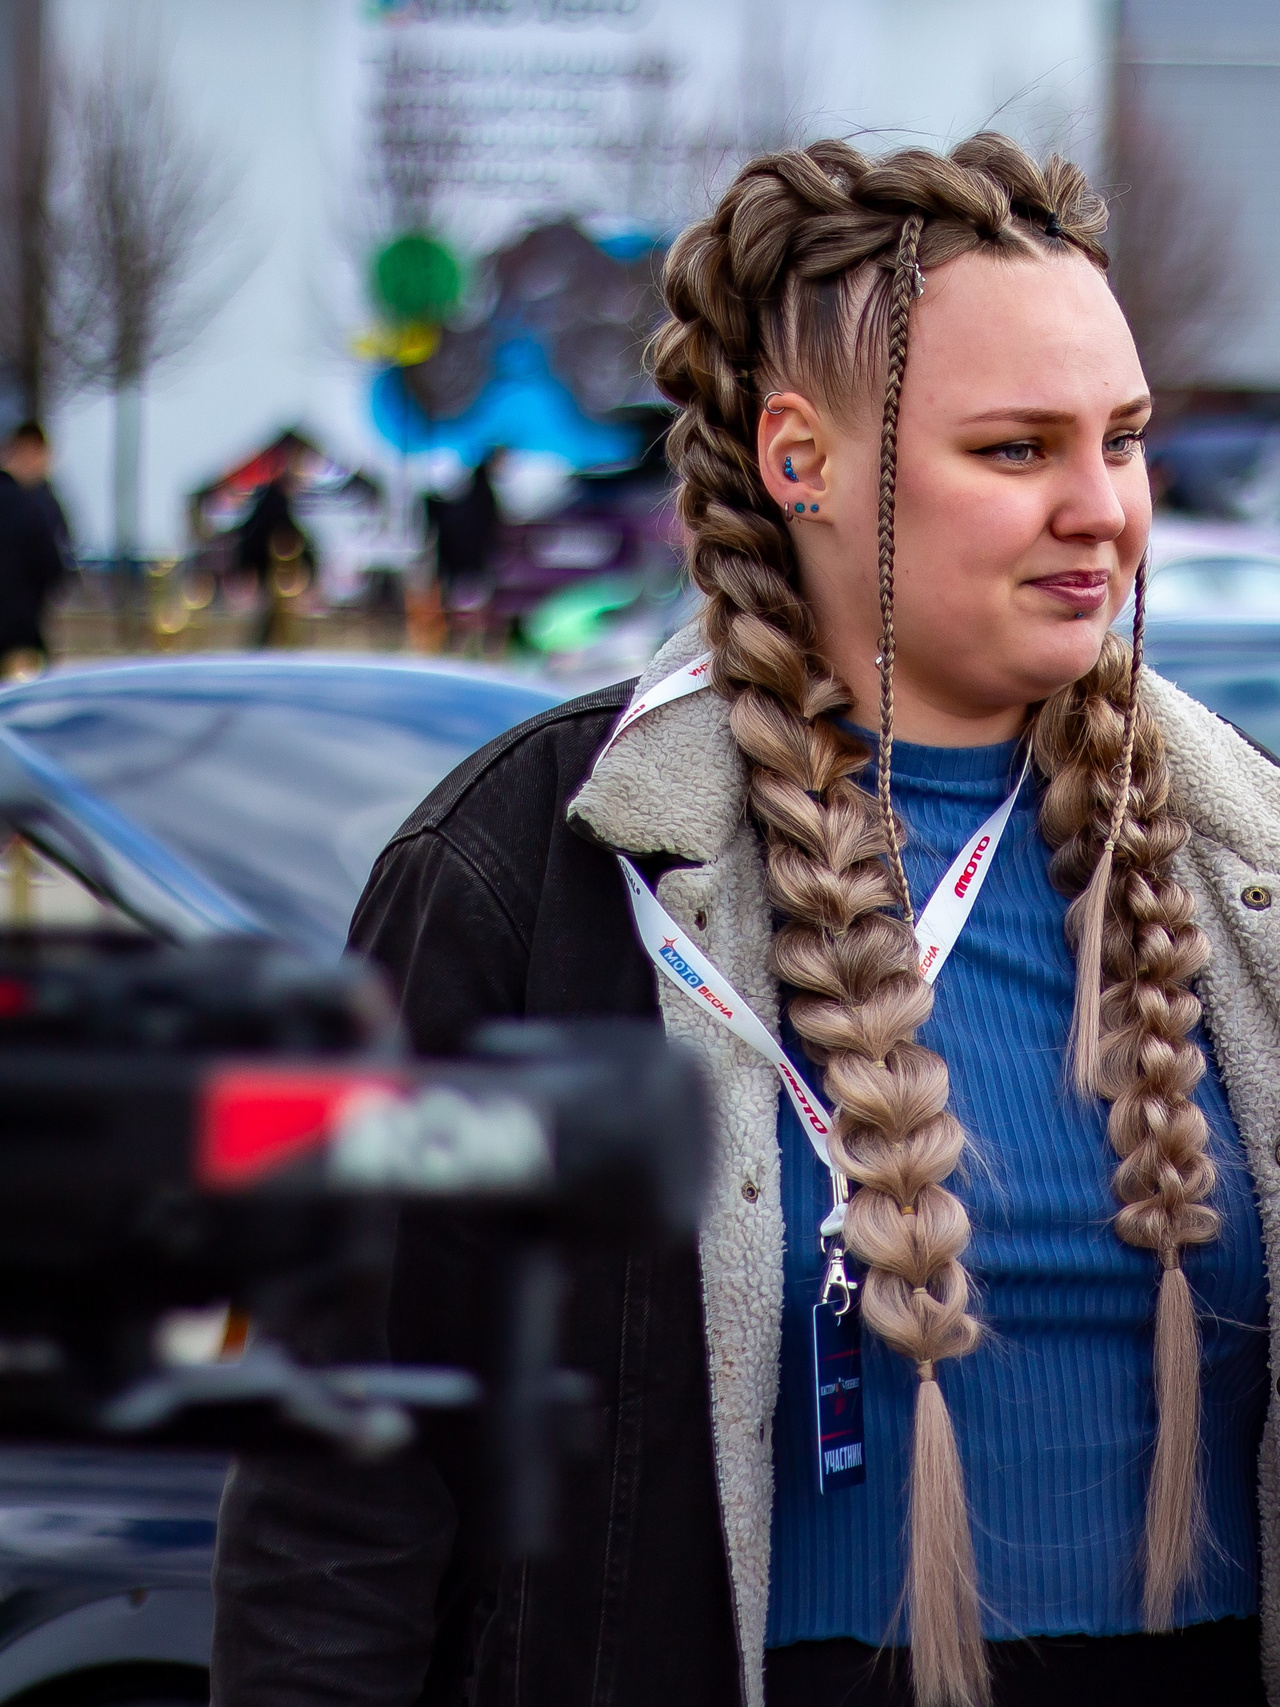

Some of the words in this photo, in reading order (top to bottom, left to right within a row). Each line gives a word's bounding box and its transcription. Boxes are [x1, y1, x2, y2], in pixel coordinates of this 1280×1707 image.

[919, 945, 940, 978] ЕСНА
[663, 950, 700, 987] МОТО
[697, 985, 734, 1020] ВЕСНА
[824, 1442, 863, 1475] УЧАСТНИК
